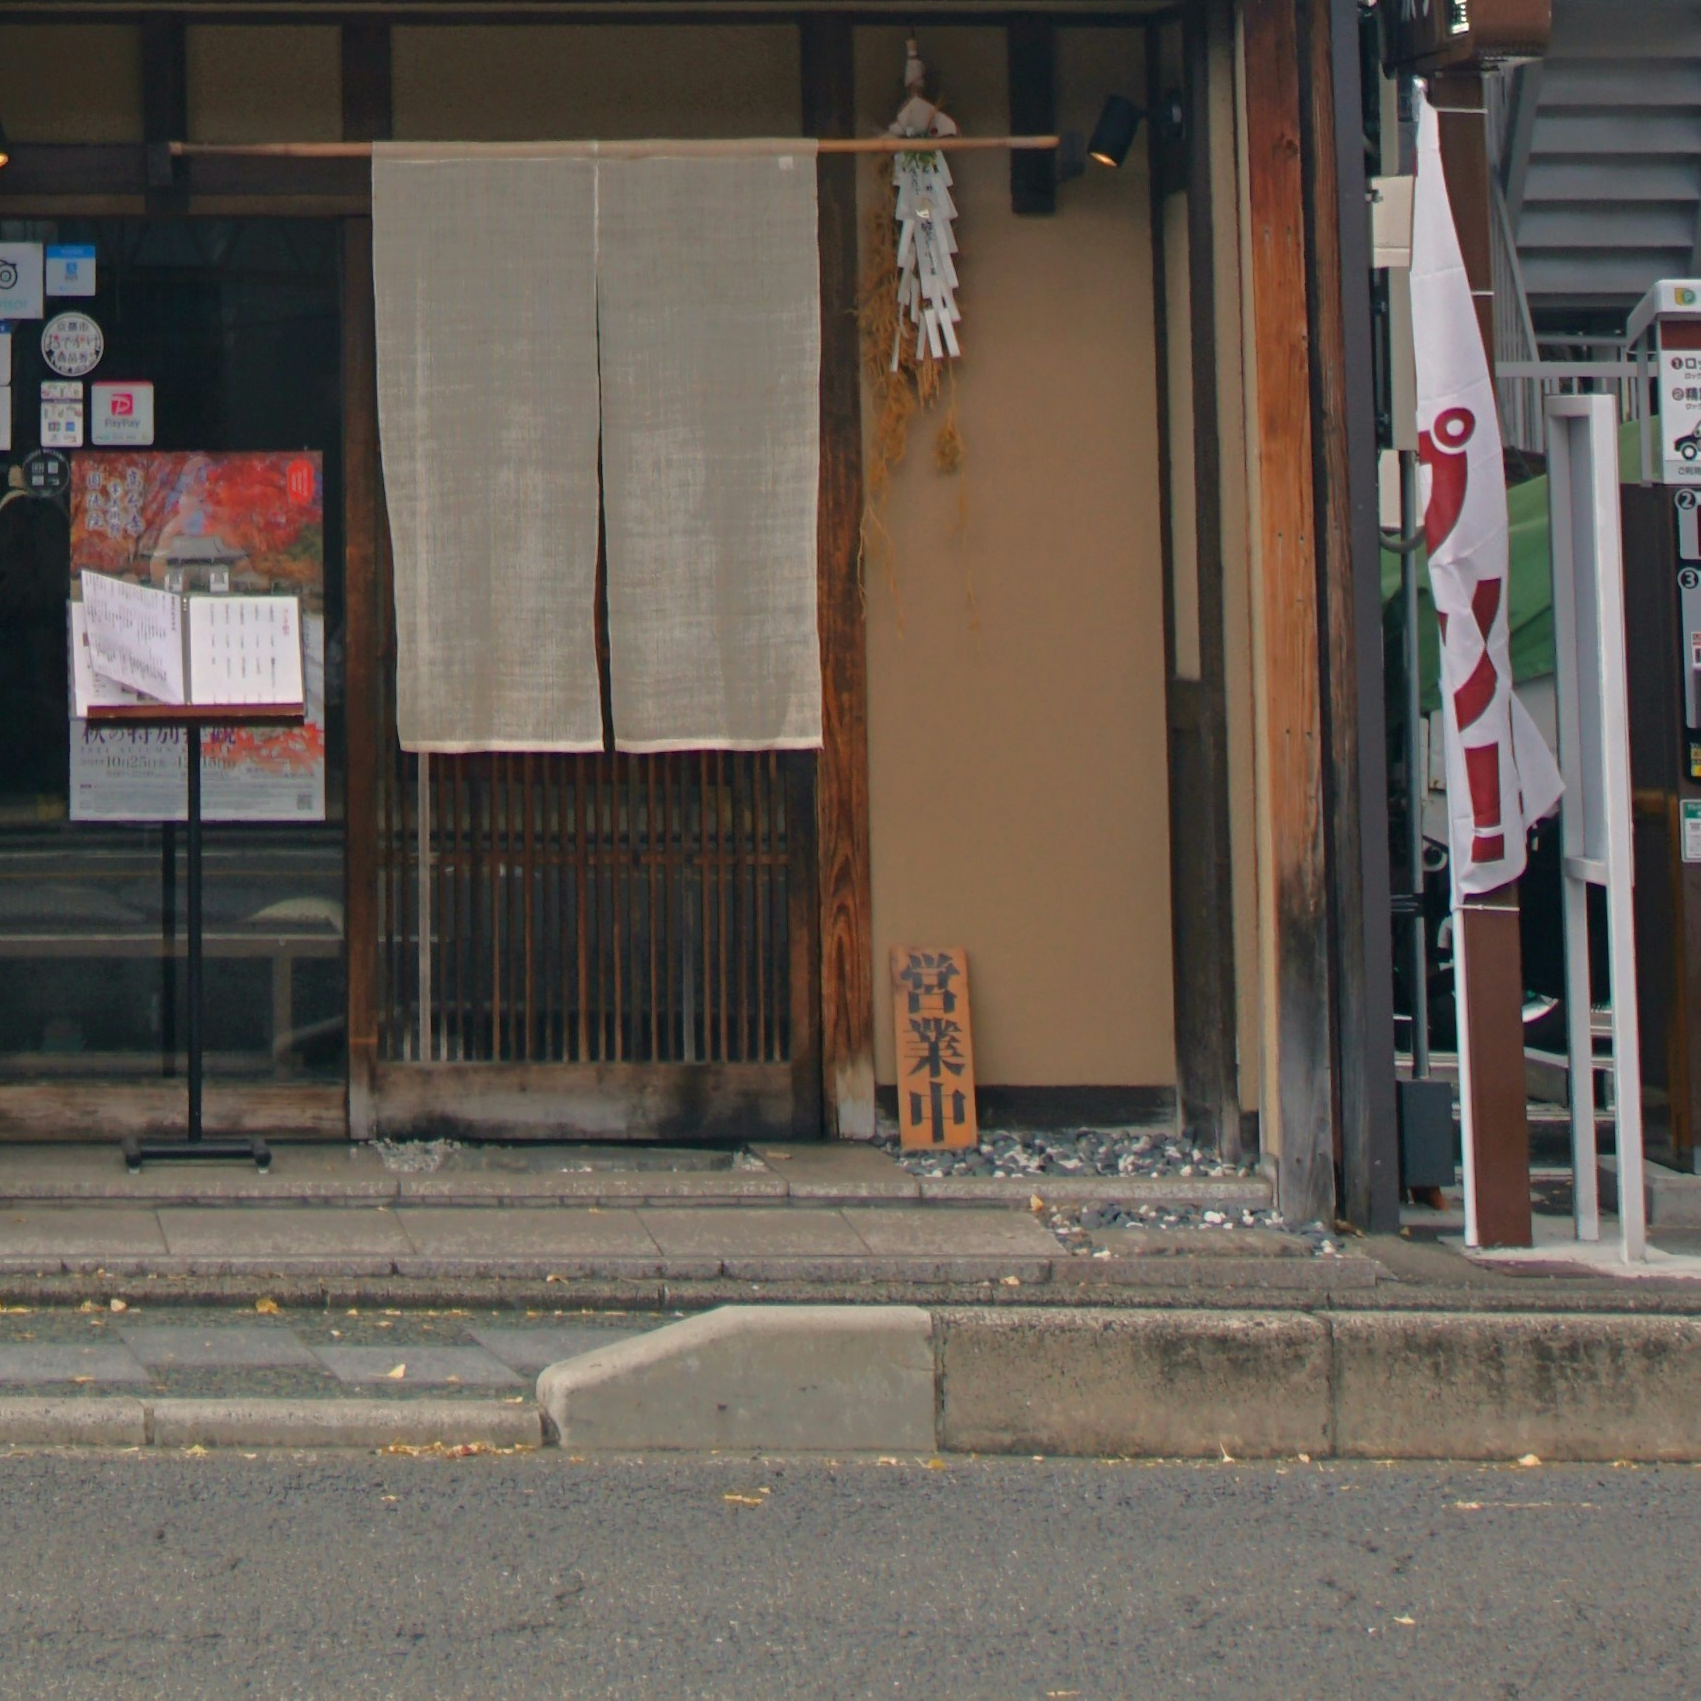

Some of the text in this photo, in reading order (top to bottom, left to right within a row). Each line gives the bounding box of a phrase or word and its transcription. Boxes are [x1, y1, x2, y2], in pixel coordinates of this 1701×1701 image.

[104, 418, 141, 430] PayPay
[900, 953, 967, 1144] 営業中
